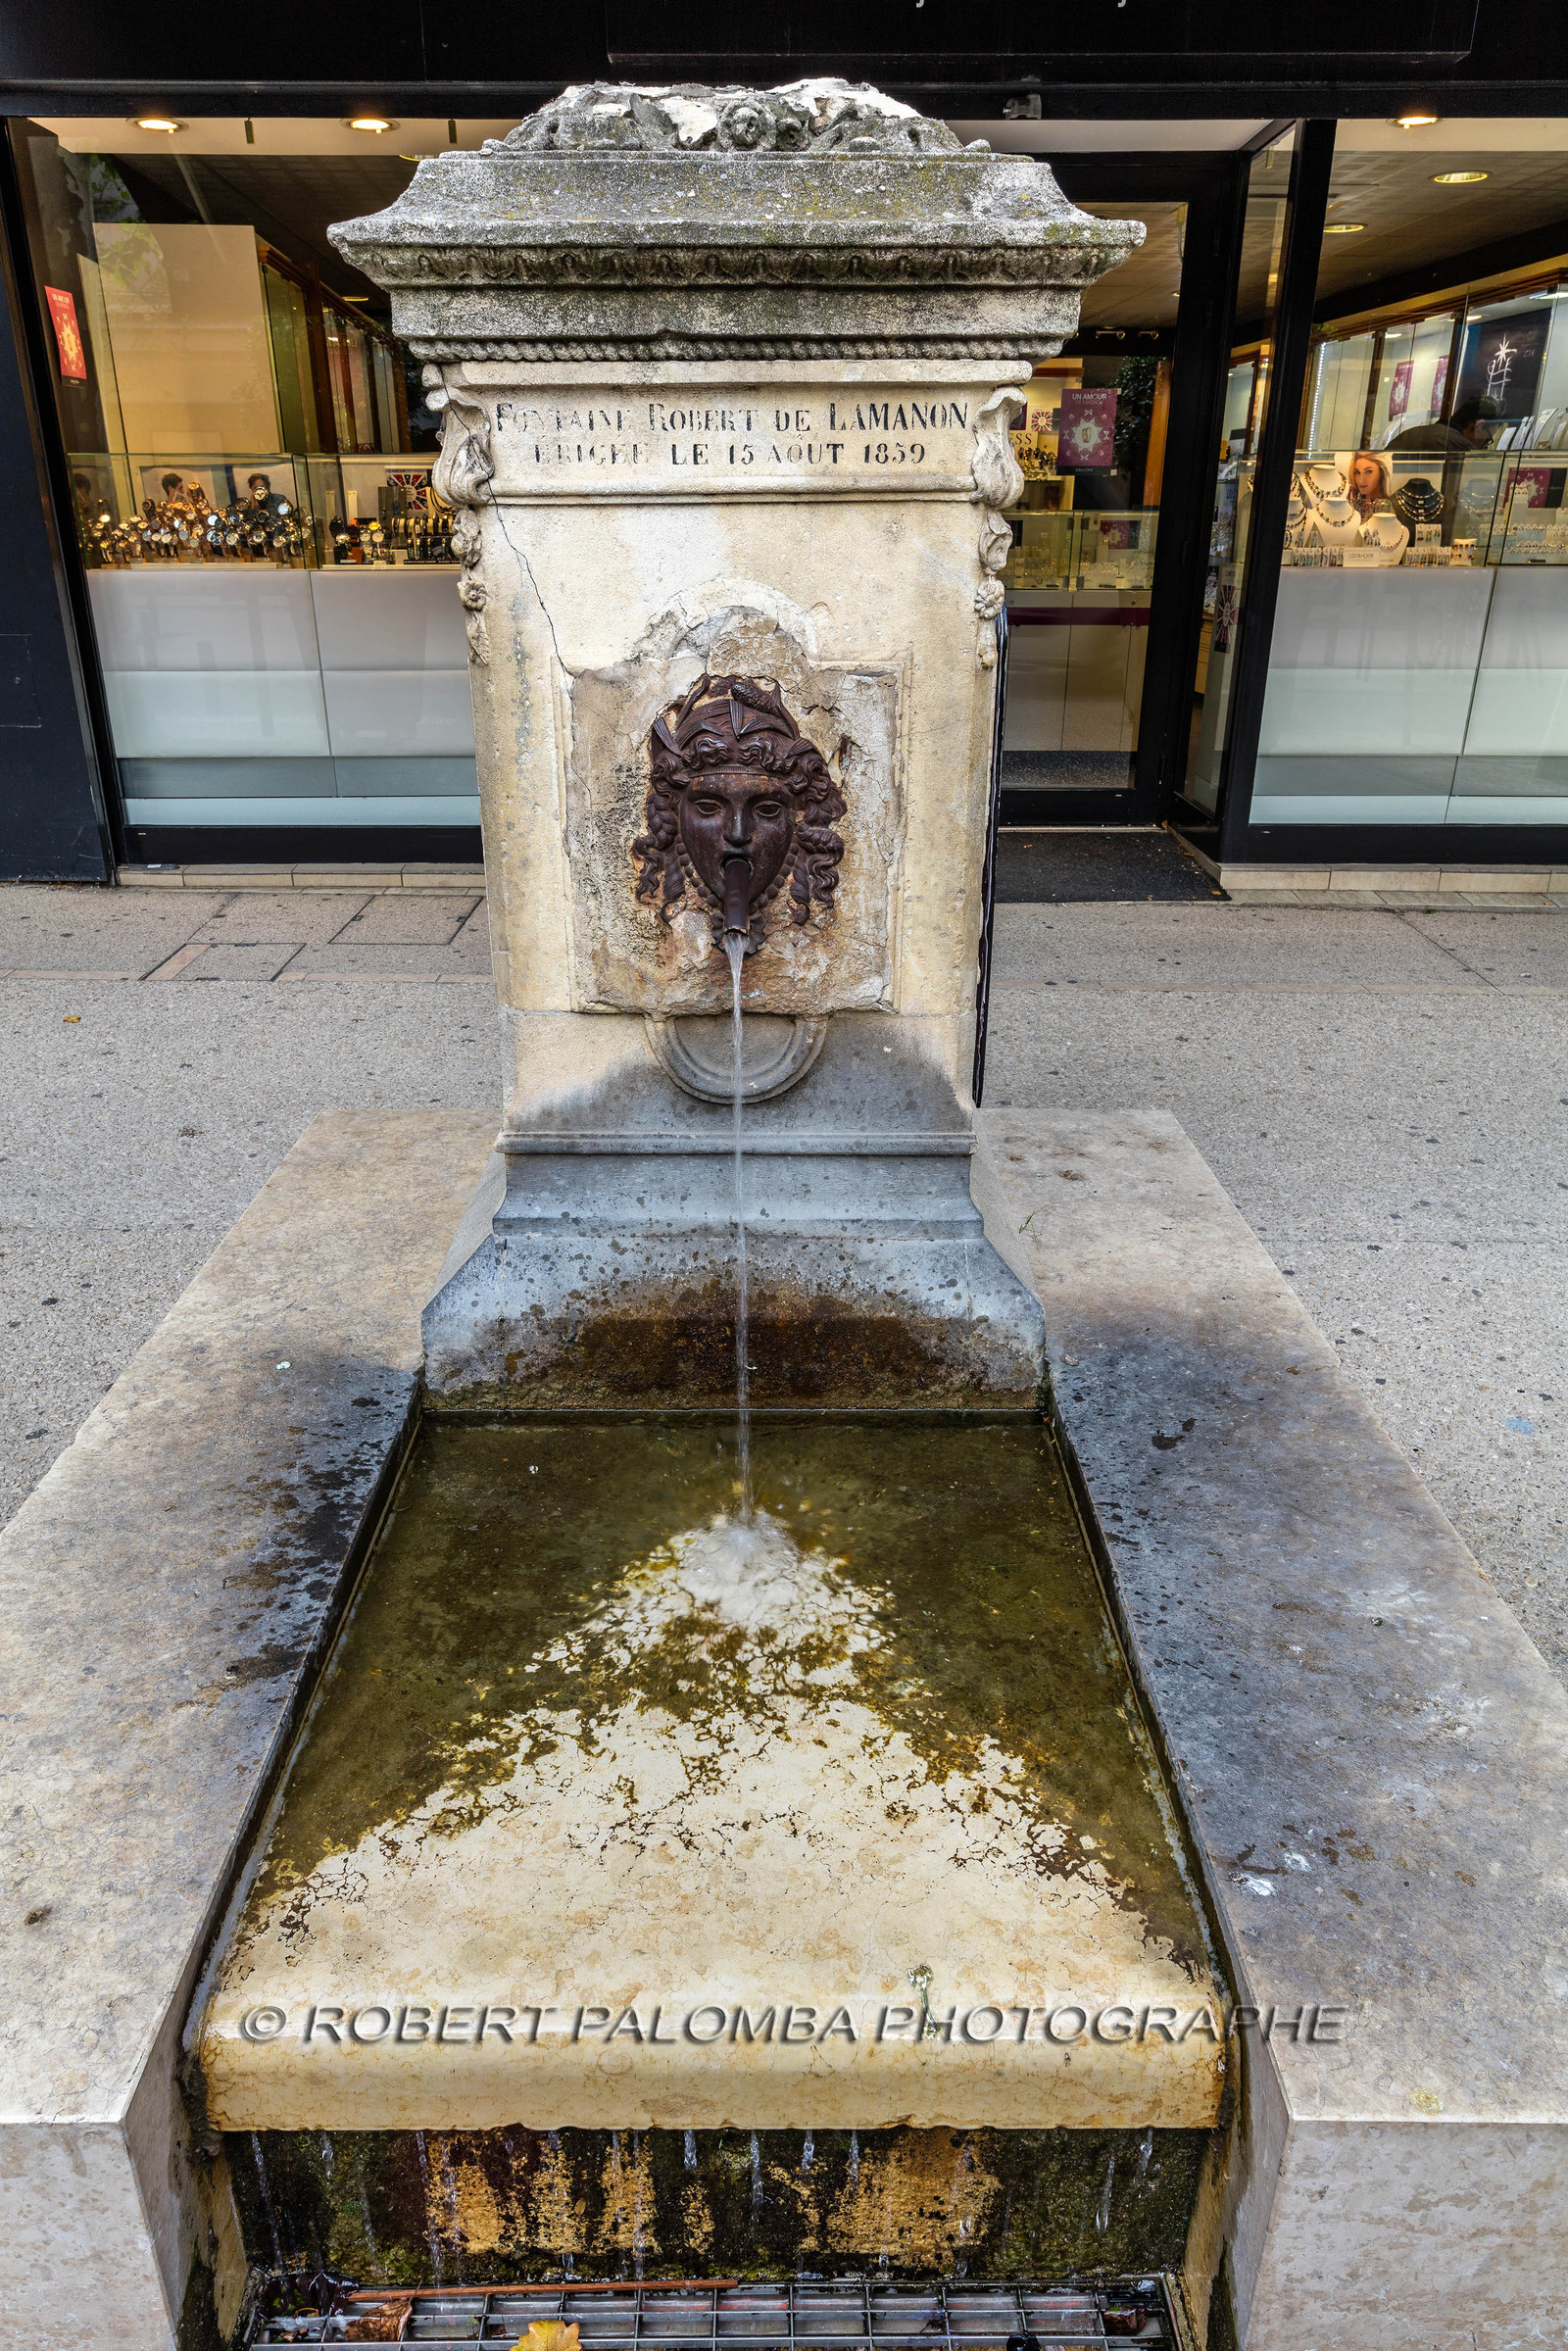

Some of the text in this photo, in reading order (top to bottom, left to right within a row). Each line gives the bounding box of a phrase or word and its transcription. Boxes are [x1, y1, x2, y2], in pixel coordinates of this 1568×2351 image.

[649, 403, 760, 432] ROBERT
[774, 410, 810, 432] DE
[829, 402, 968, 431] LAMANON
[670, 444, 710, 465] LE
[728, 444, 755, 465] 15
[863, 443, 926, 465] 1859
